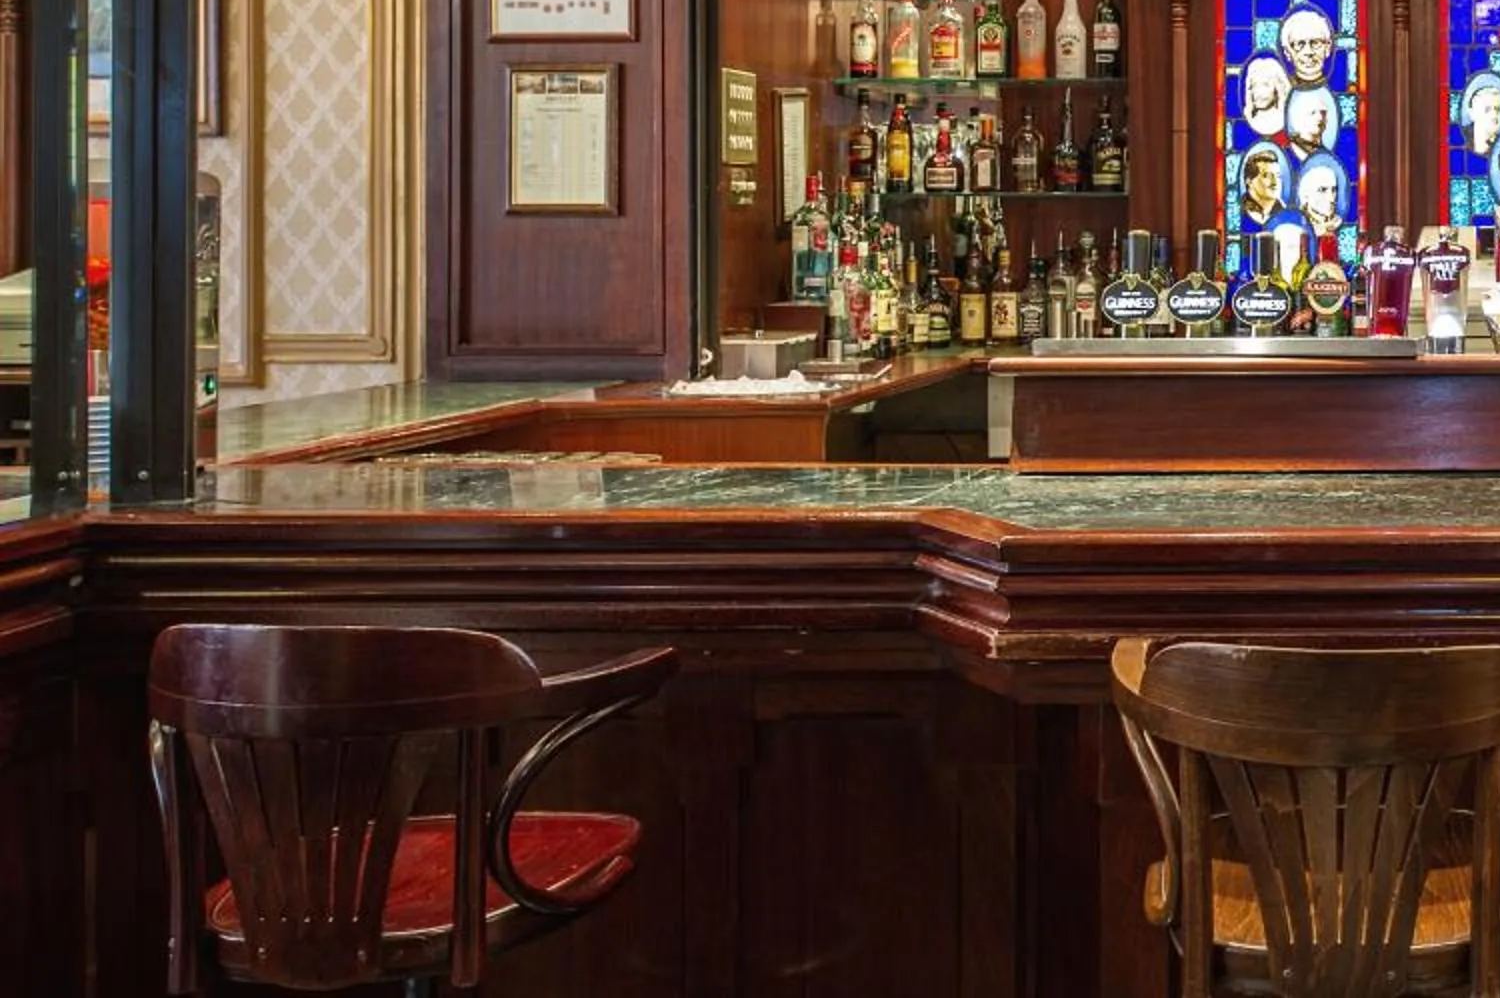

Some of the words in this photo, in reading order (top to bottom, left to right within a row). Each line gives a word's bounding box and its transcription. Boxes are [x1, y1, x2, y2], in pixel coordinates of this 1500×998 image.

[1105, 296, 1157, 310] GUINNESS
[1169, 295, 1221, 309] GUINNESS
[1235, 297, 1287, 310] GUINNESS
